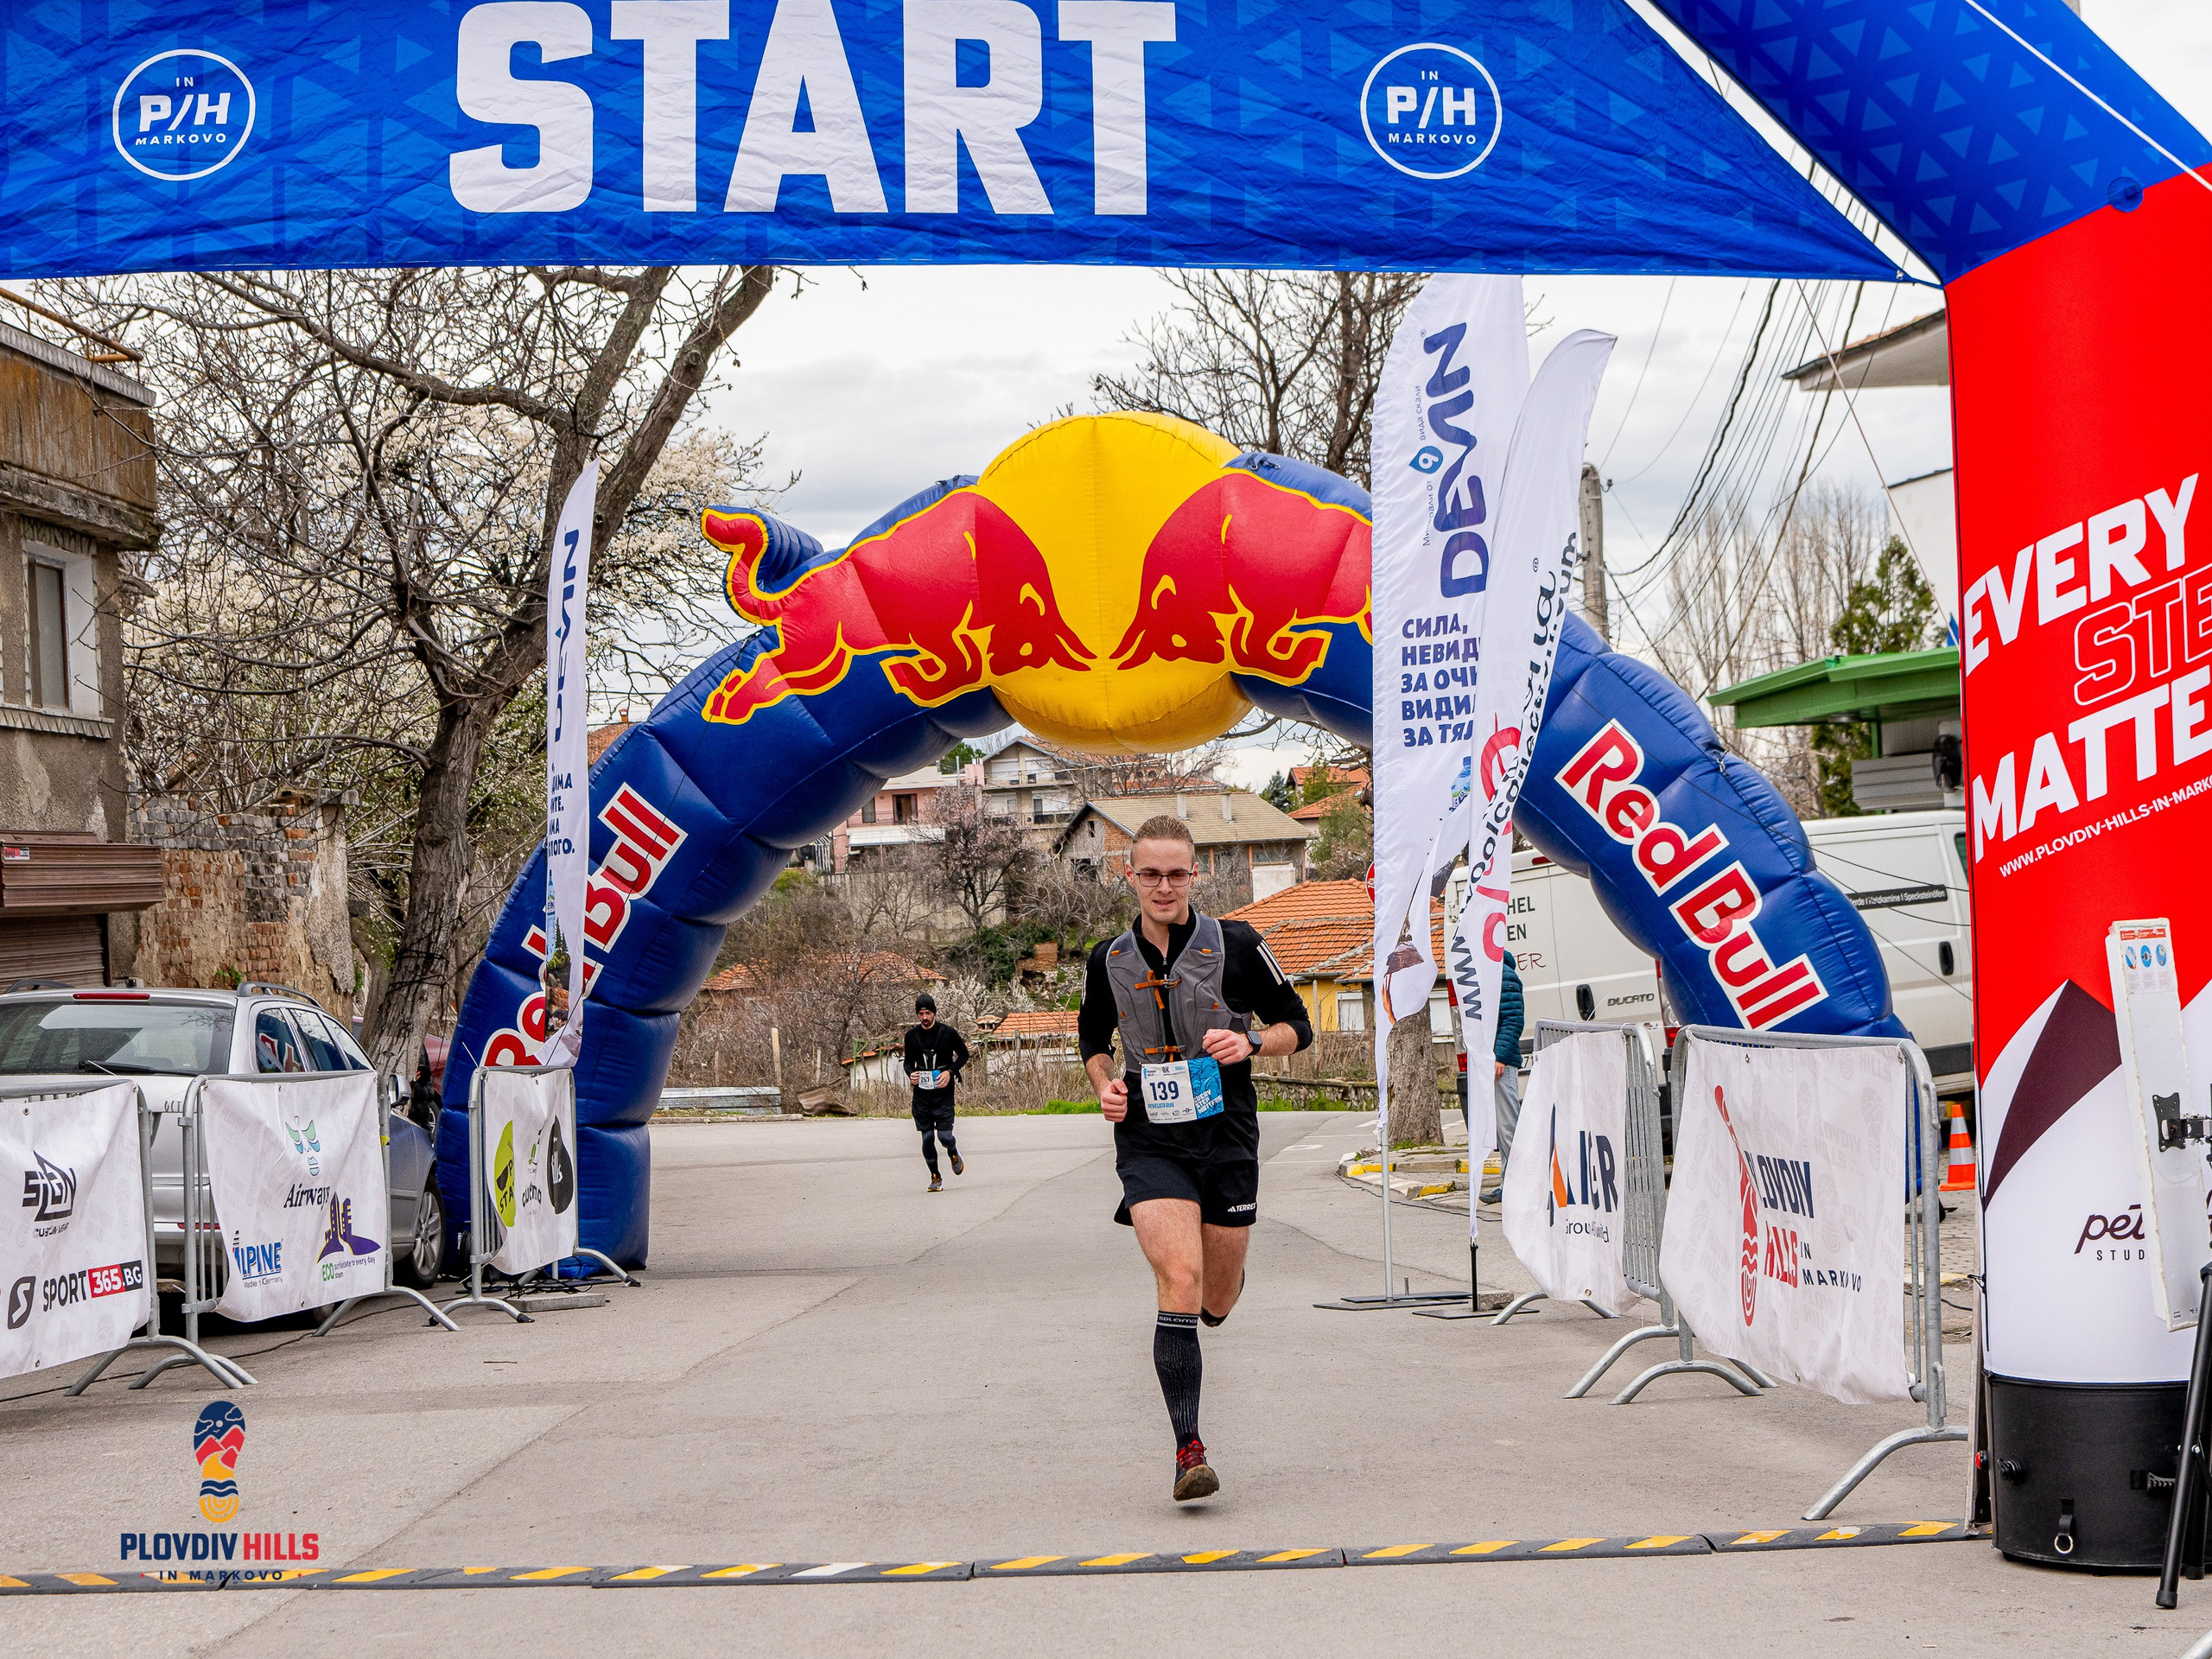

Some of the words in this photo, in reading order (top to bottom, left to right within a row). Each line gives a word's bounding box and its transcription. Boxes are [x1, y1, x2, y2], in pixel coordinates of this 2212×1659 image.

[175, 77, 194, 87] IN
[1421, 70, 1439, 80] IN
[139, 92, 231, 132] P/H
[450, 0, 1176, 216] START
[1386, 86, 1476, 129] P/H
[135, 132, 226, 146] MARKOVO
[1388, 132, 1477, 145] MARKOVO
[1963, 472, 2199, 678] EVERY
[1402, 613, 1468, 639] СИЛА,
[1402, 637, 1481, 667] НЕВИД
[1401, 672, 1428, 694] ЗА
[1402, 694, 1476, 721] ВИДИ
[1403, 726, 1433, 747] ЗА
[1972, 664, 2212, 865] MATTE
[1999, 774, 2212, 878] WWW.PLOVDIV-HILLS-IN-MARK
[584, 789, 681, 946] Bull
[1560, 725, 1722, 890] Red
[1676, 867, 1821, 1031] Bull
[1514, 952, 1547, 971] ER
[1607, 993, 1655, 1007] DUCATO
[1149, 1080, 1179, 1101] 139
[283, 1183, 331, 1211] Airways
[499, 1179, 515, 1215] STA
[1800, 1241, 1812, 1260] IN
[2096, 1249, 2145, 1262] STUD
[321, 1262, 335, 1281] ECO
